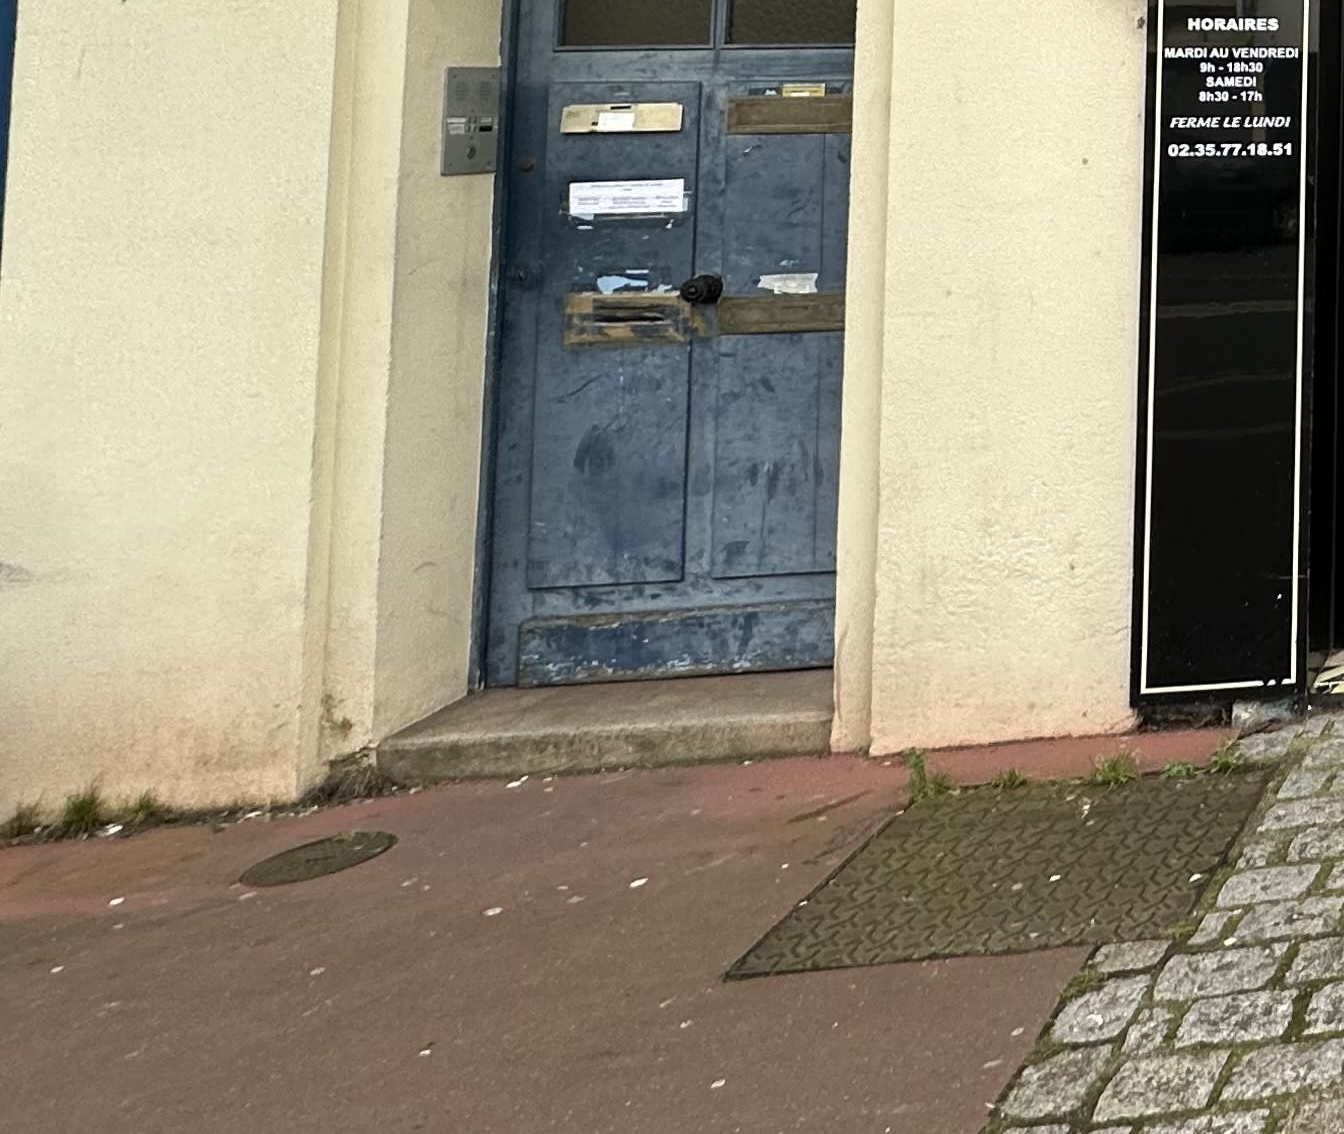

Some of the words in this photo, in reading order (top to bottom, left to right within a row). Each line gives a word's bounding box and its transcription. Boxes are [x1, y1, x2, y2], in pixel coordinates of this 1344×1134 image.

[1187, 17, 1280, 31] HORAIRES
[1164, 47, 1207, 58] MARDI
[1209, 47, 1229, 58] AU
[1232, 47, 1299, 58] VENDREDI
[1199, 62, 1216, 73] 9h
[1227, 61, 1264, 73] 18h30
[1206, 76, 1257, 87] SAMEDI
[1198, 91, 1229, 102] 8h30
[1240, 91, 1263, 102] 17h
[1170, 116, 1221, 128] FERME
[1223, 117, 1242, 128] LE
[1244, 116, 1291, 128] LUNDI
[1167, 142, 1293, 157] 02.35.77.18.51
